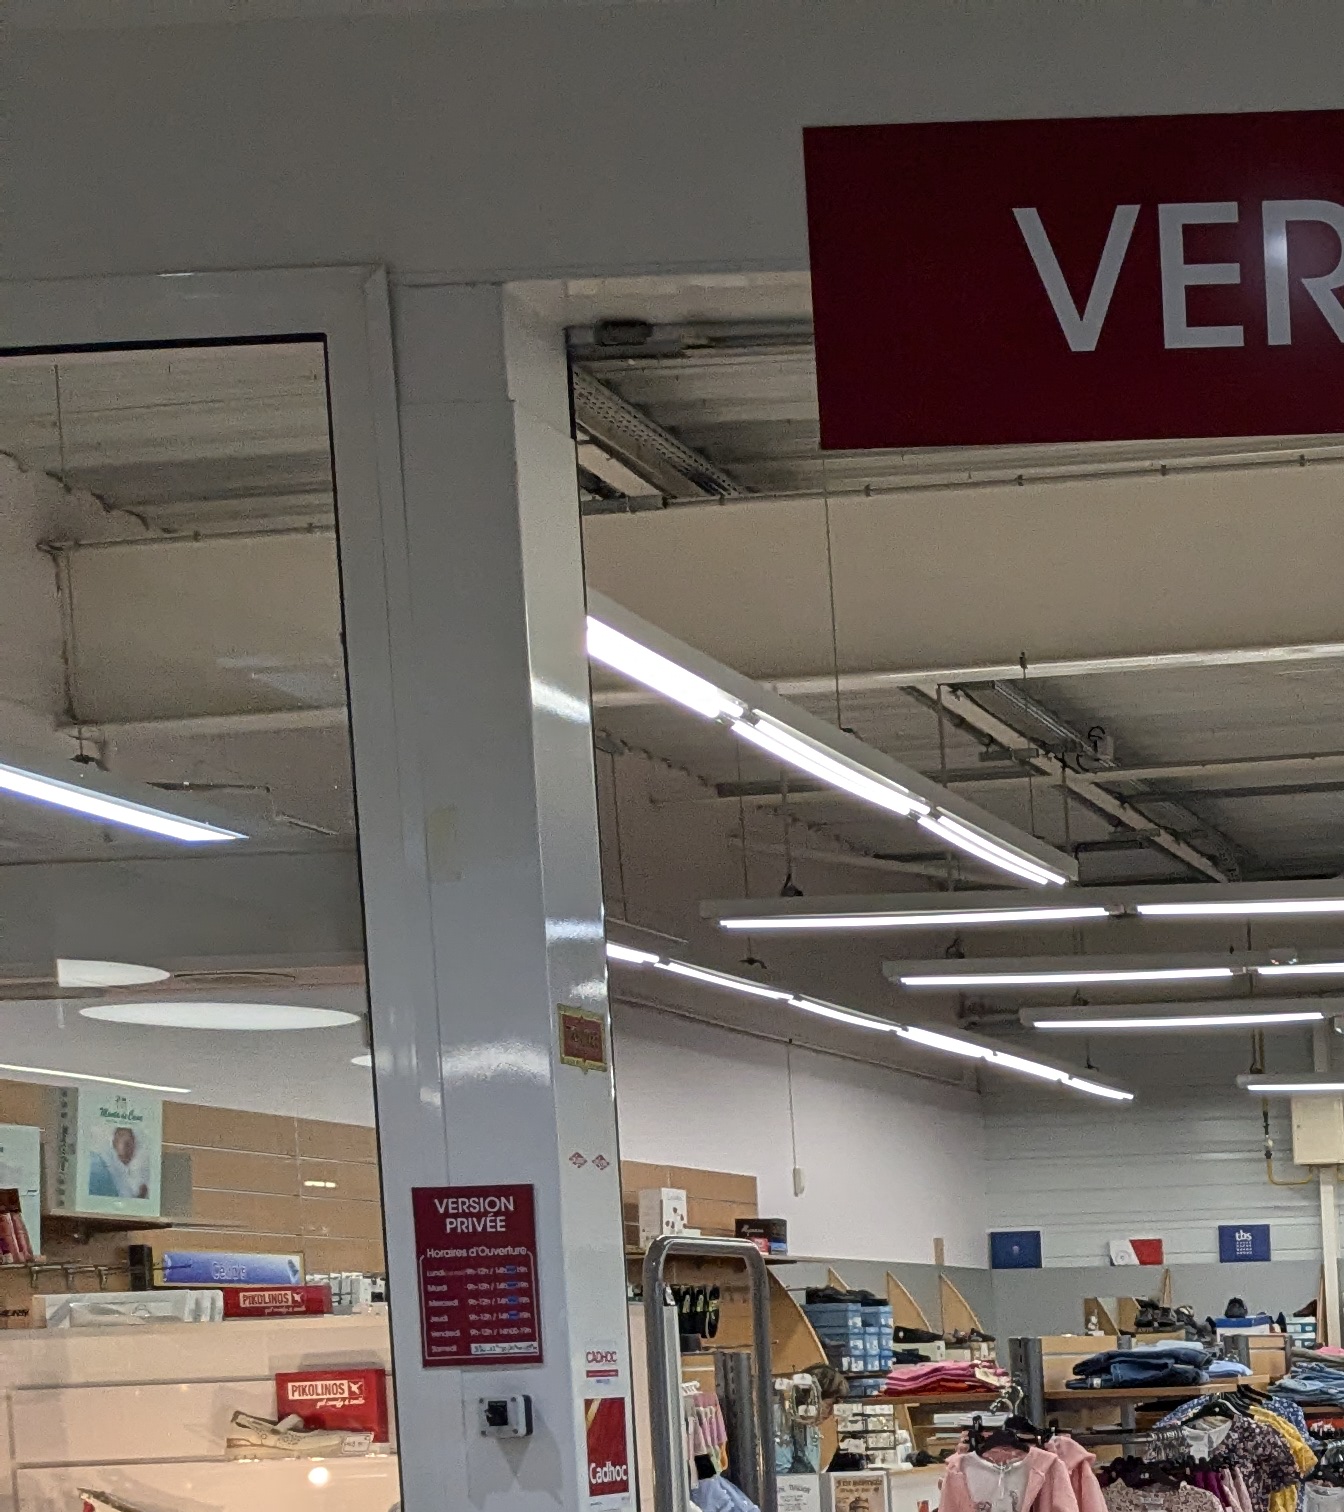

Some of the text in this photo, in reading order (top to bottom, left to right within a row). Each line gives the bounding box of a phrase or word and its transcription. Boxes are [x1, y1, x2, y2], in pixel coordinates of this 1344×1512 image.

[434, 1196, 514, 1214] VERSION
[446, 1212, 506, 1233] PRIVÉE
[1235, 1229, 1252, 1241] tbs
[427, 1246, 527, 1258] Horaires d'Ouverture
[242, 1293, 290, 1306] PIKOLINOS
[586, 1351, 617, 1363] CADHOC
[291, 1382, 346, 1398] PIKOLINOS
[590, 1461, 628, 1484] Cadhoc
